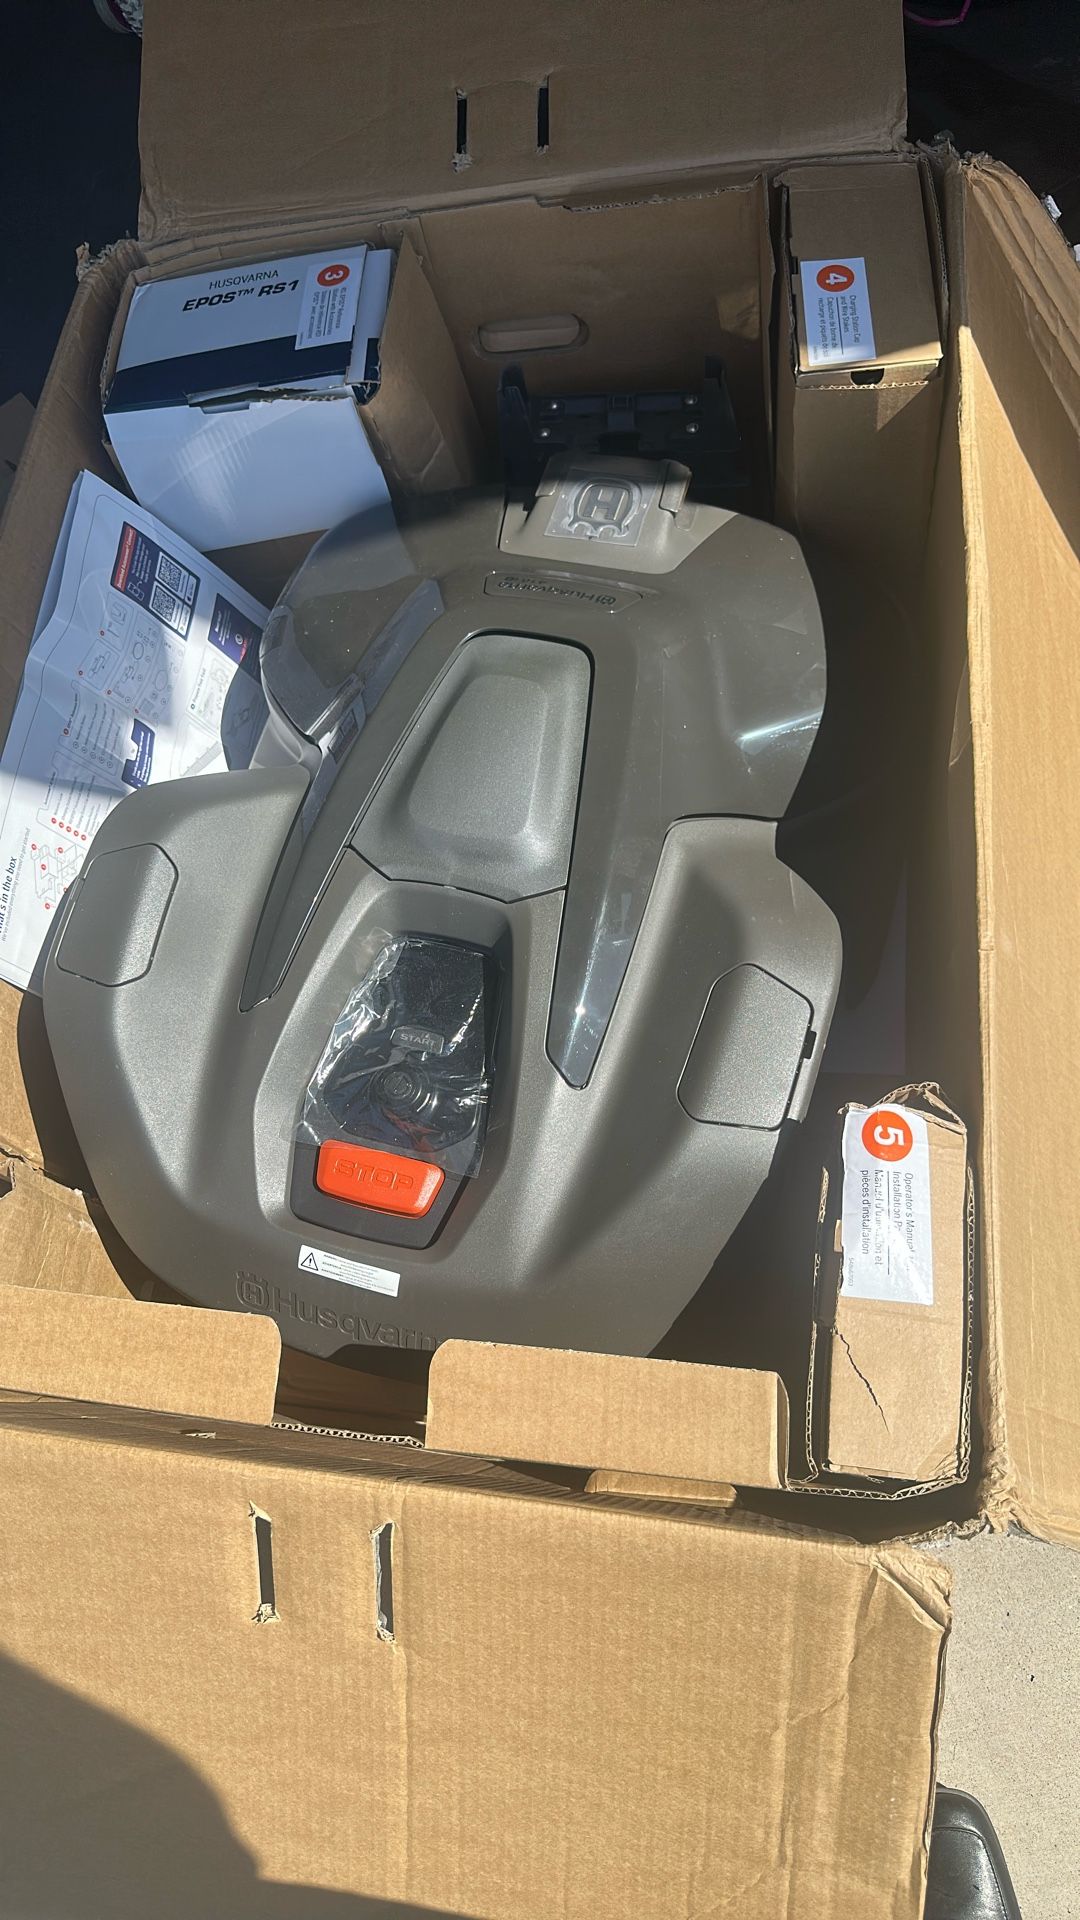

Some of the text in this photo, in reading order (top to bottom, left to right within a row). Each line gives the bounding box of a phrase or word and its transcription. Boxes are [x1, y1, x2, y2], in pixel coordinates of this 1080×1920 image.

[208, 270, 279, 290] HUSQVARNA
[325, 270, 344, 280] 3
[825, 272, 848, 285] 4
[182, 280, 300, 312] EPOS™ RS1
[849, 295, 857, 316] Charging
[5, 856, 17, 875] box
[2, 875, 13, 892] the
[0, 892, 9, 904] in
[400, 1032, 437, 1047] START
[873, 1124, 905, 1147] 5
[332, 1158, 414, 1190] STOP
[860, 1170, 870, 1198] pièces
[892, 1171, 903, 1220] Installation
[272, 1286, 438, 1349] Husqvarn
